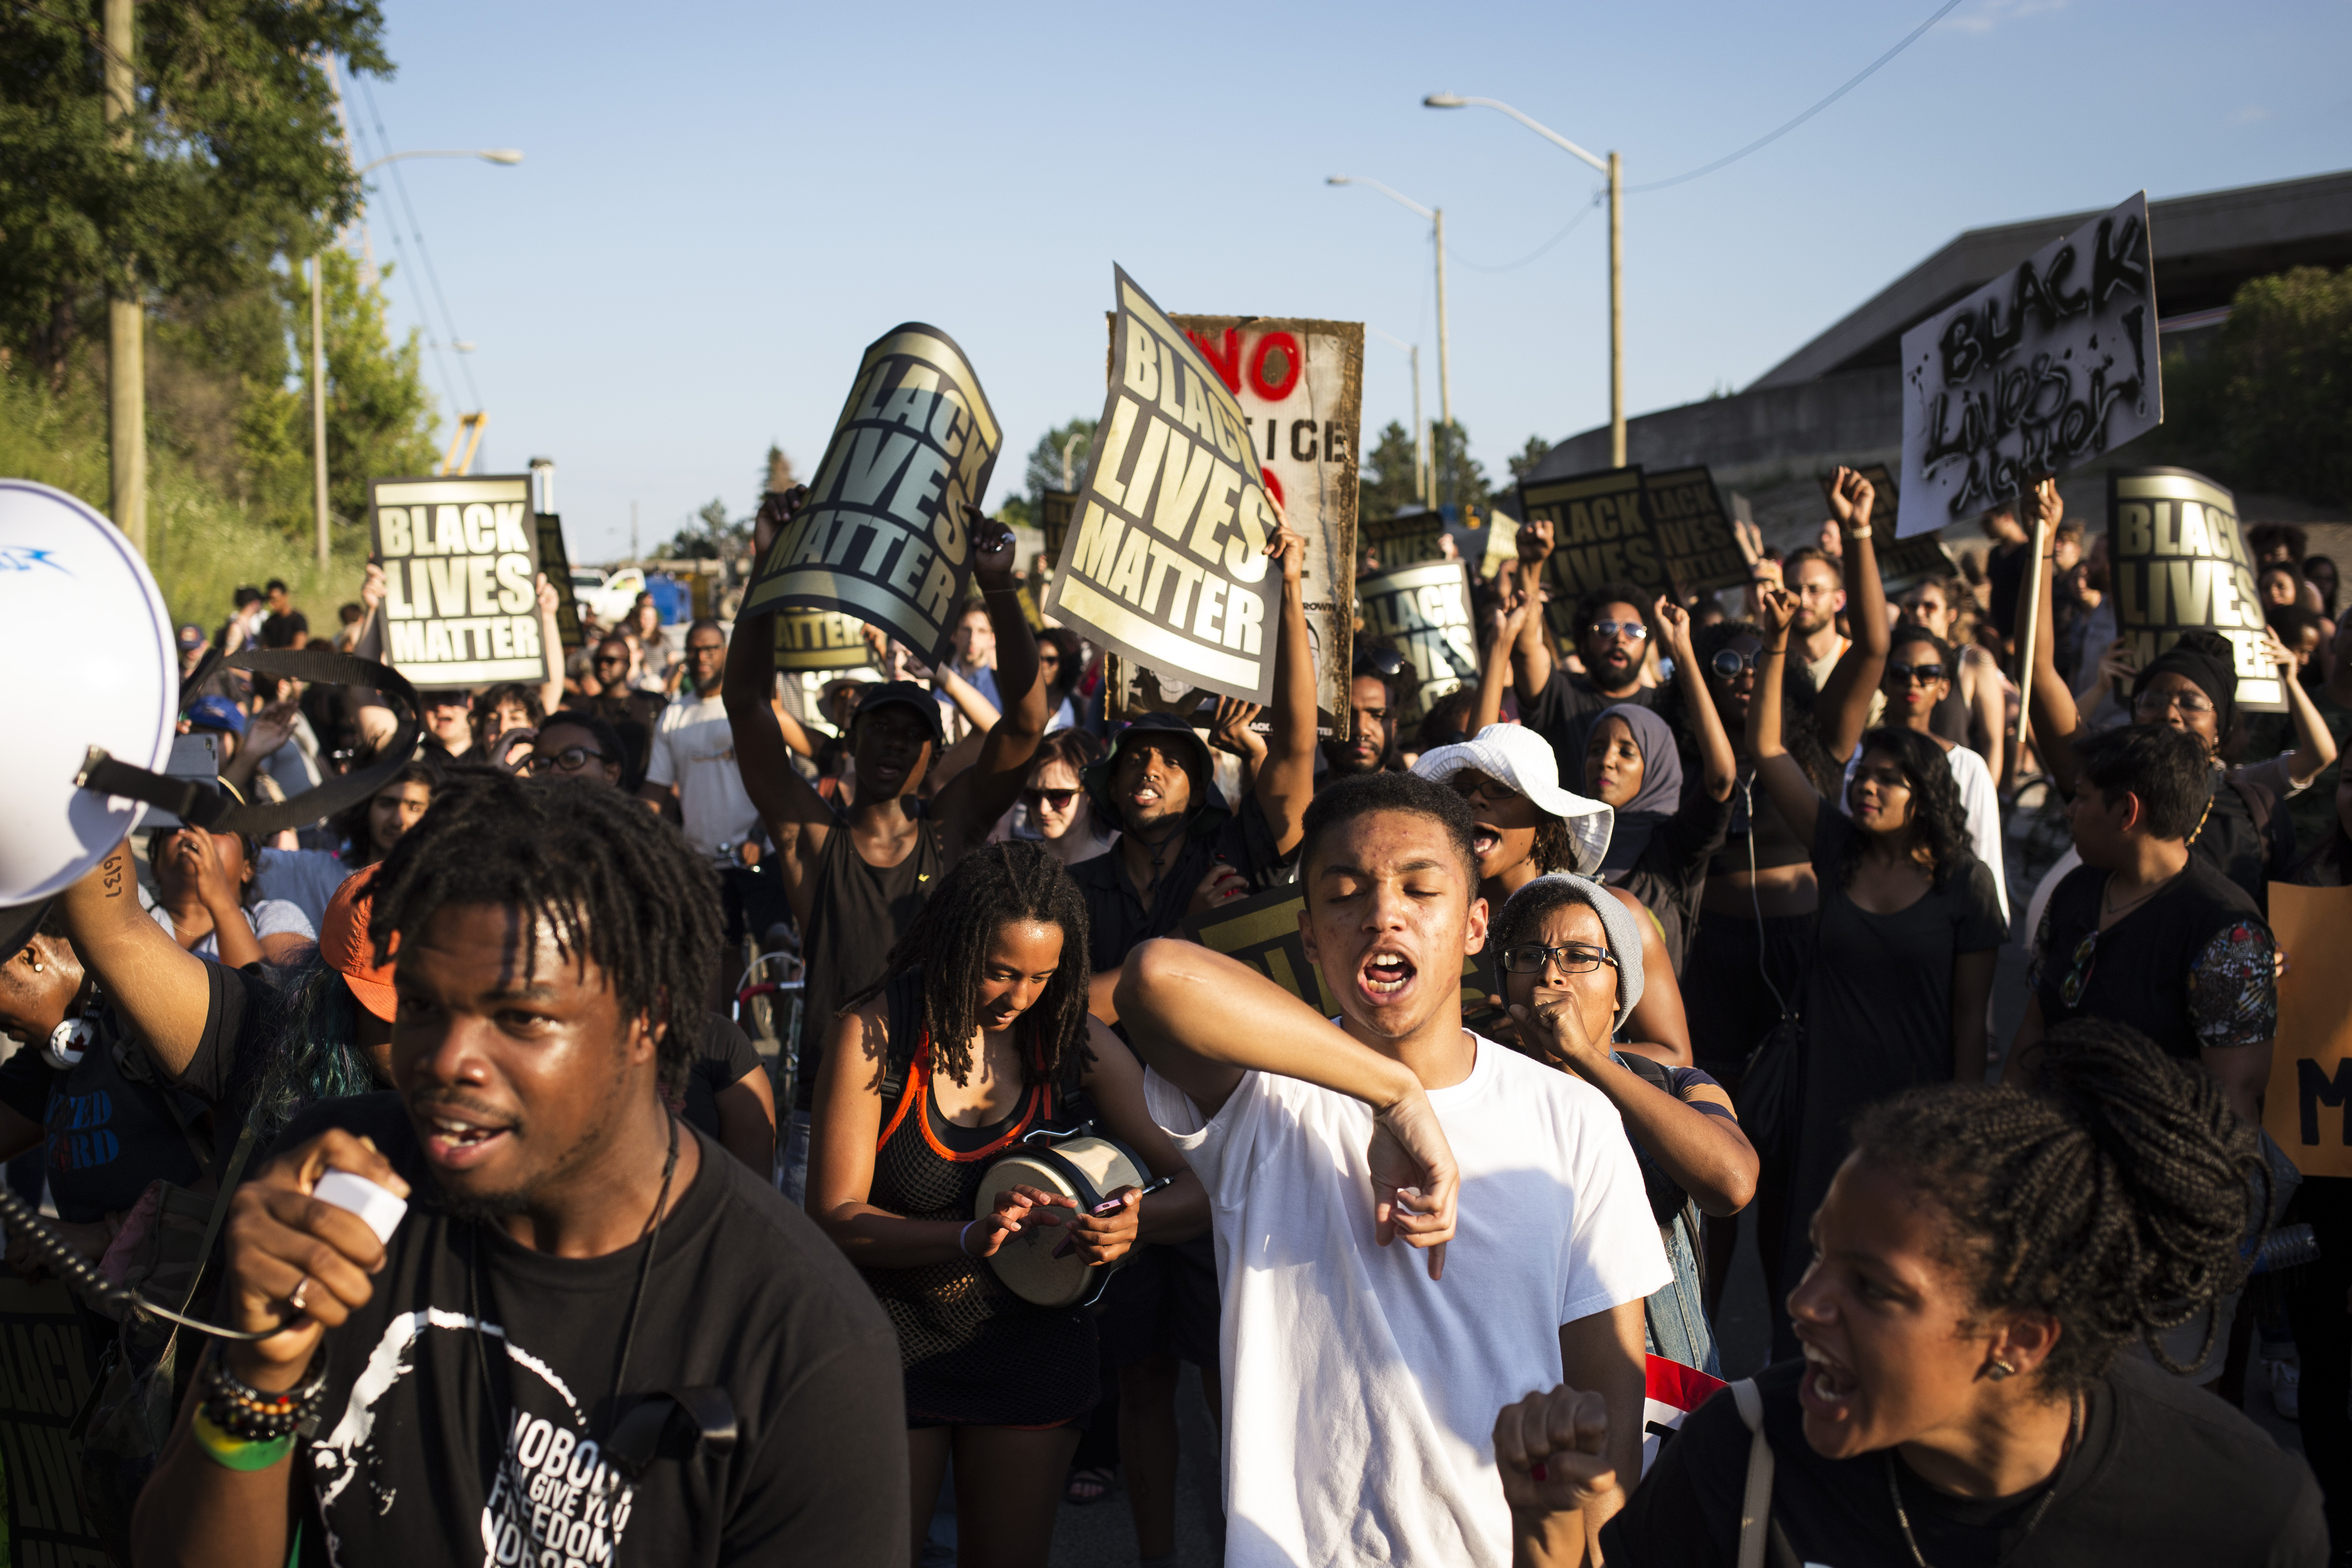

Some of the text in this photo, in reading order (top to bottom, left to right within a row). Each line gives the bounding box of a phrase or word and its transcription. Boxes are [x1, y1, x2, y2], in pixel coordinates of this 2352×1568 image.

[1938, 214, 2145, 384] BLACK
[1186, 327, 1299, 401] NO
[1123, 314, 1266, 488] BLACK
[1244, 417, 1348, 462] ICE
[800, 427, 971, 565] IVES
[1093, 395, 1275, 583] LIVES
[1648, 484, 1718, 520] LACK
[378, 503, 530, 557] BLACK
[1656, 513, 1732, 556] IVES
[2119, 501, 2249, 567] BLACK
[383, 553, 536, 619] LIVES
[761, 509, 956, 626] MATTER
[1071, 500, 1265, 655] MATTER
[2119, 559, 2265, 630] LIVES
[775, 611, 865, 650] ATTER
[1303, 602, 1337, 611] ROWN
[1363, 584, 1469, 637] BLACK
[388, 615, 541, 663] MATTER
[1395, 626, 1477, 683] VES
[2125, 629, 2278, 679] MER
[0, 1420, 100, 1539] LIV
[529, 1472, 584, 1517] GIVE
